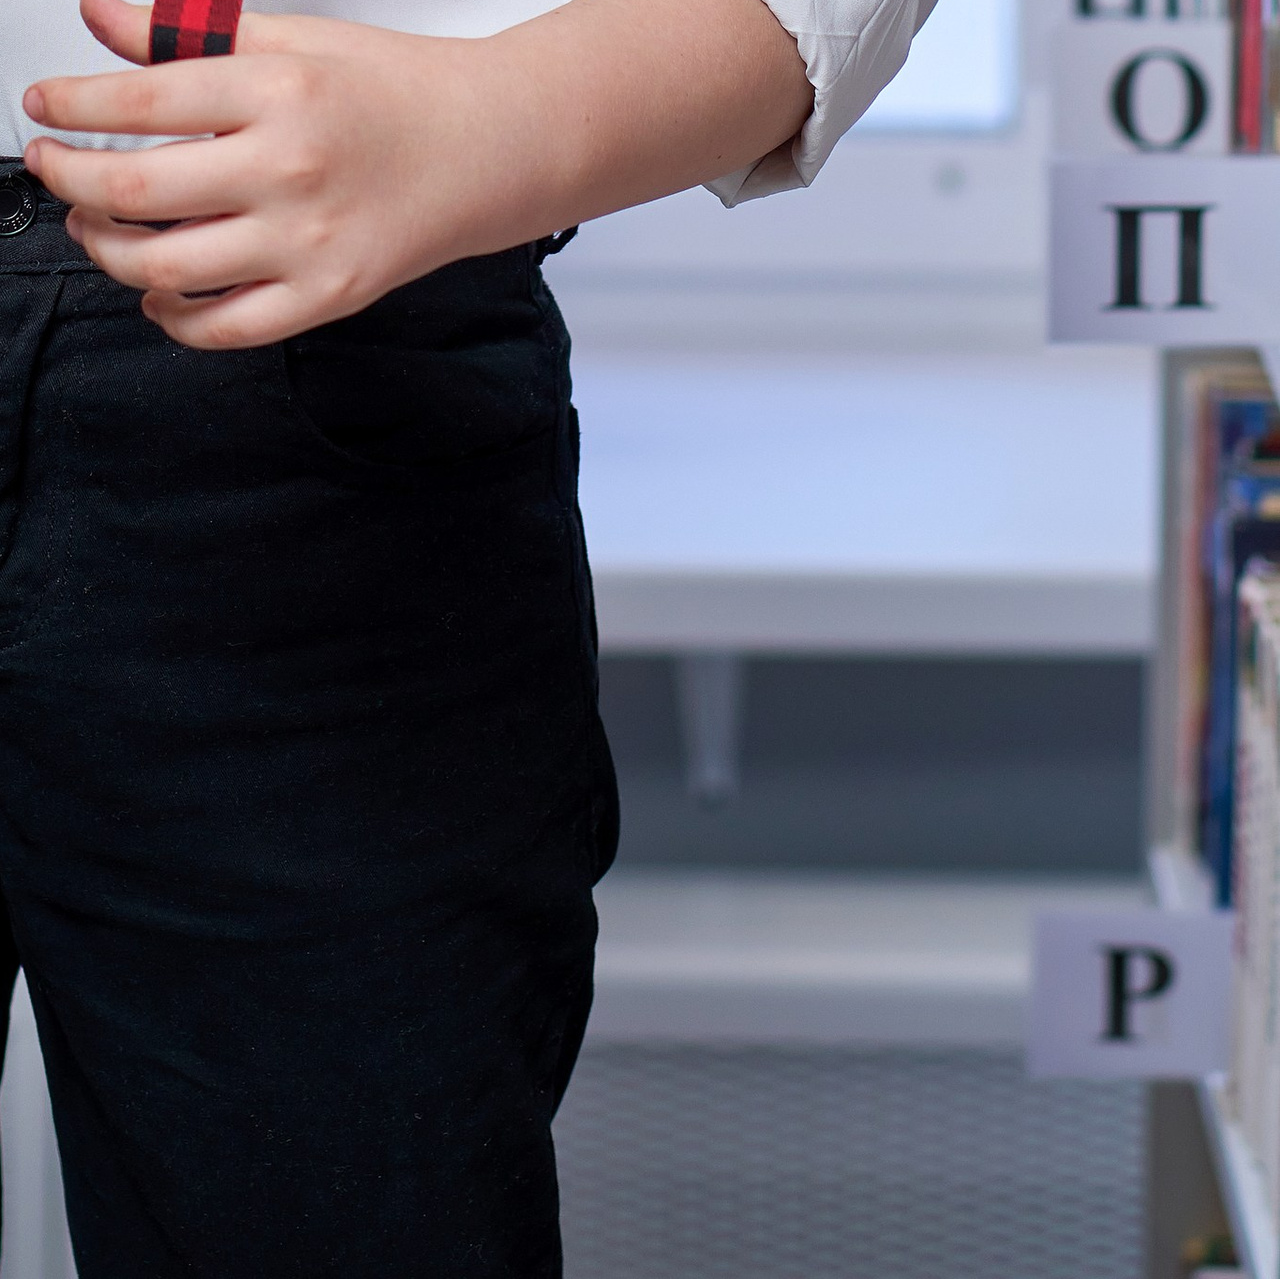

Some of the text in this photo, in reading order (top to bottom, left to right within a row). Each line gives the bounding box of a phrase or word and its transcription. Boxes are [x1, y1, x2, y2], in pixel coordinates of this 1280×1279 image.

[1107, 48, 1210, 152] О
[1101, 203, 1218, 311] П
[1100, 943, 1176, 1041] Р
